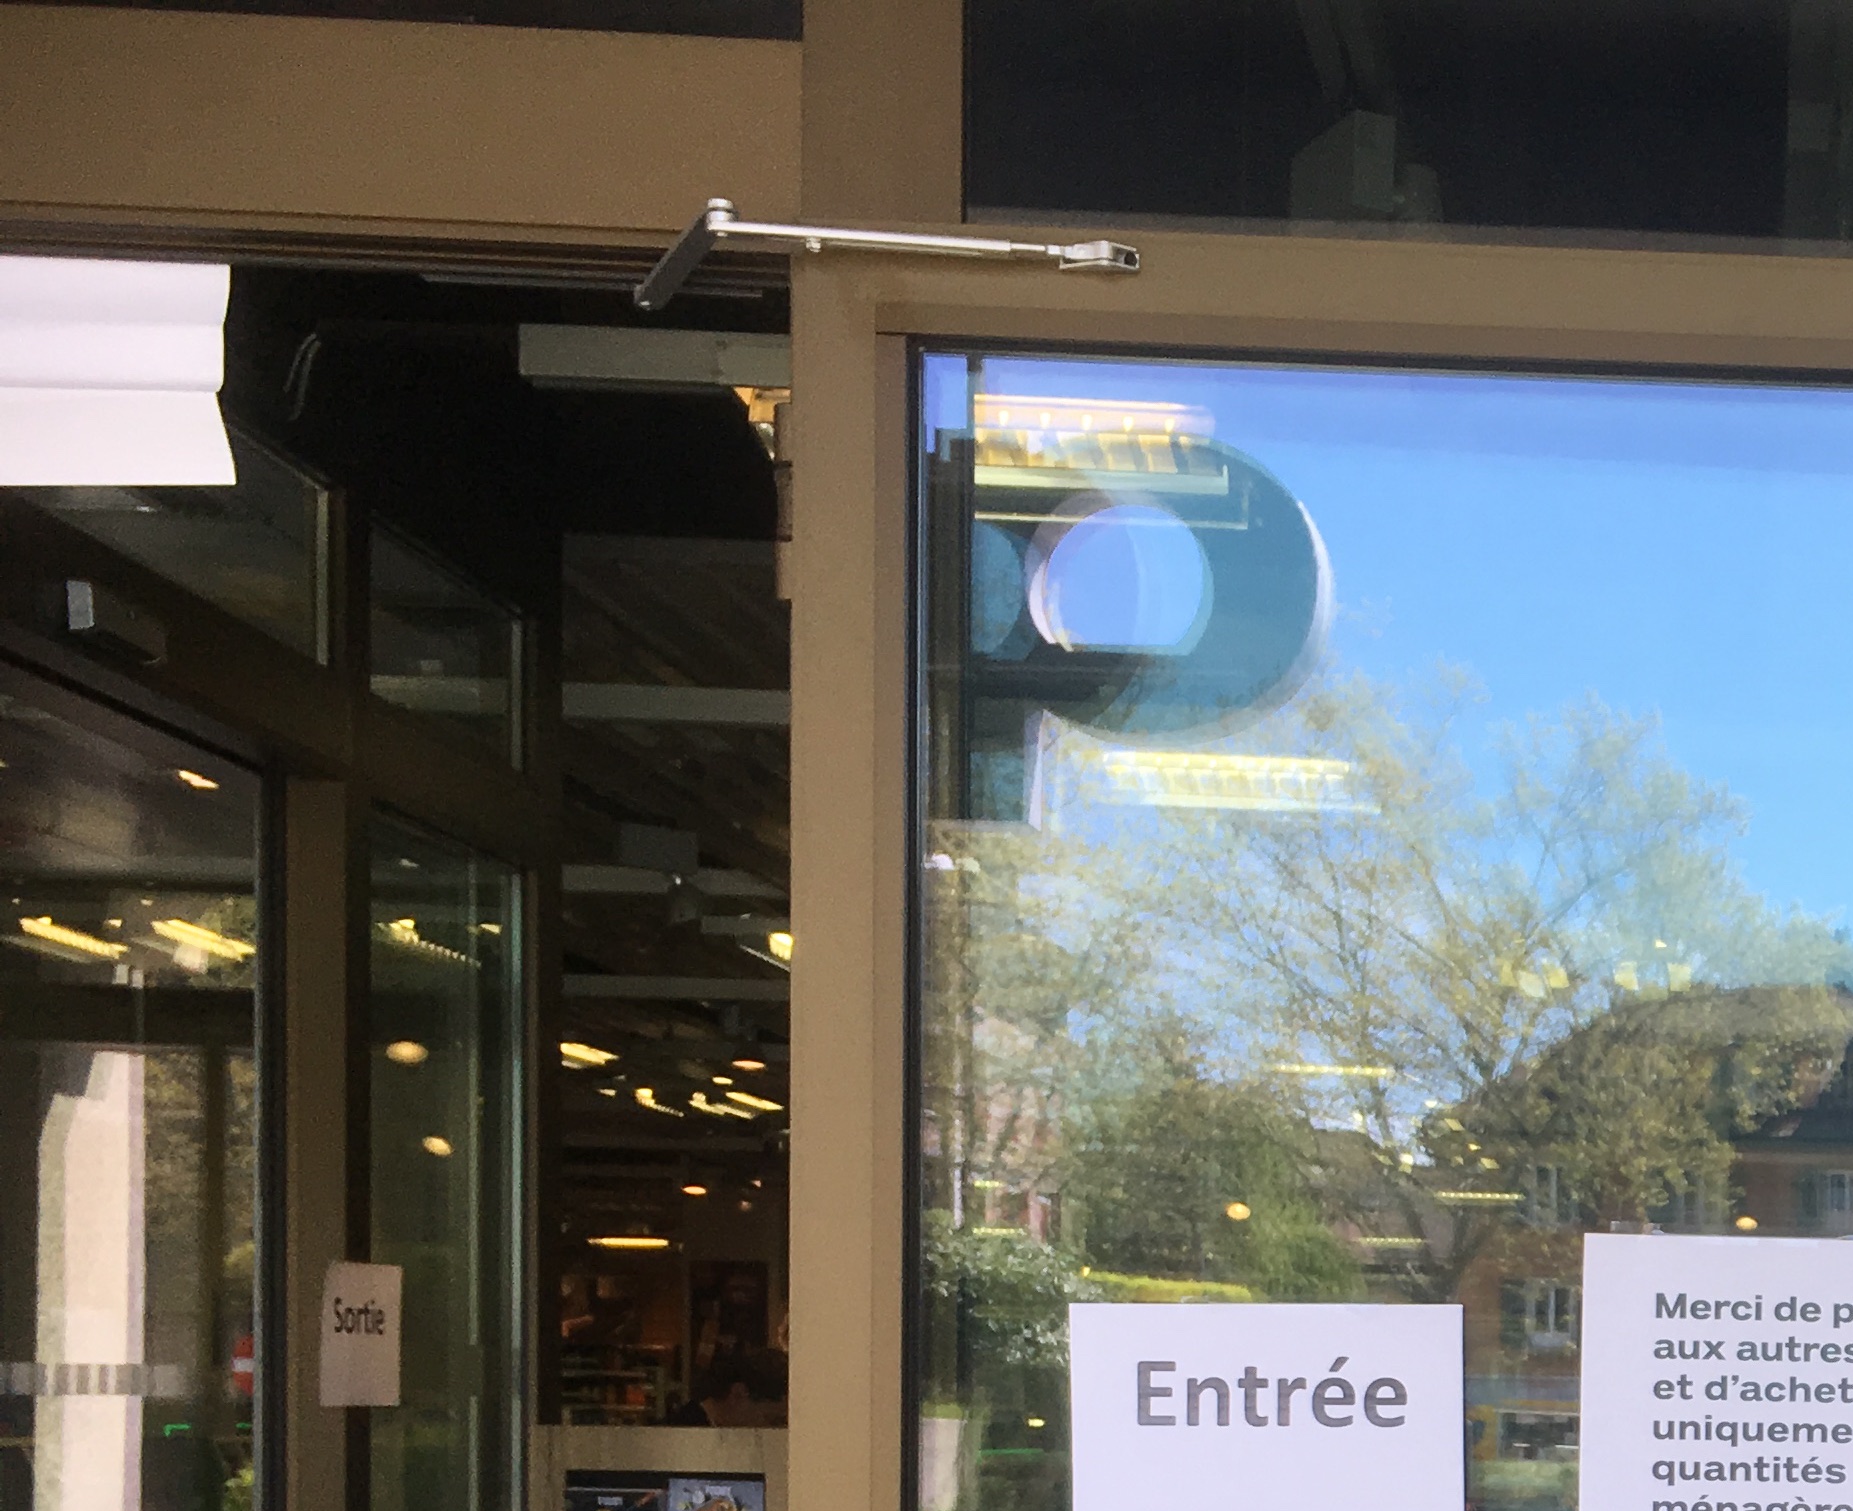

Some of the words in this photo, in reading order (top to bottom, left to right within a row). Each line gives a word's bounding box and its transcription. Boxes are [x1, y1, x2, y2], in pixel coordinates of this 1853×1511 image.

[333, 1297, 385, 1335] Sortie
[1655, 1292, 1763, 1321] Merci
[1773, 1295, 1822, 1323] de
[1653, 1338, 1726, 1361] aux
[1136, 1356, 1408, 1428] Entrée
[1652, 1374, 1694, 1401] et
[1651, 1456, 1846, 1487] quantités
